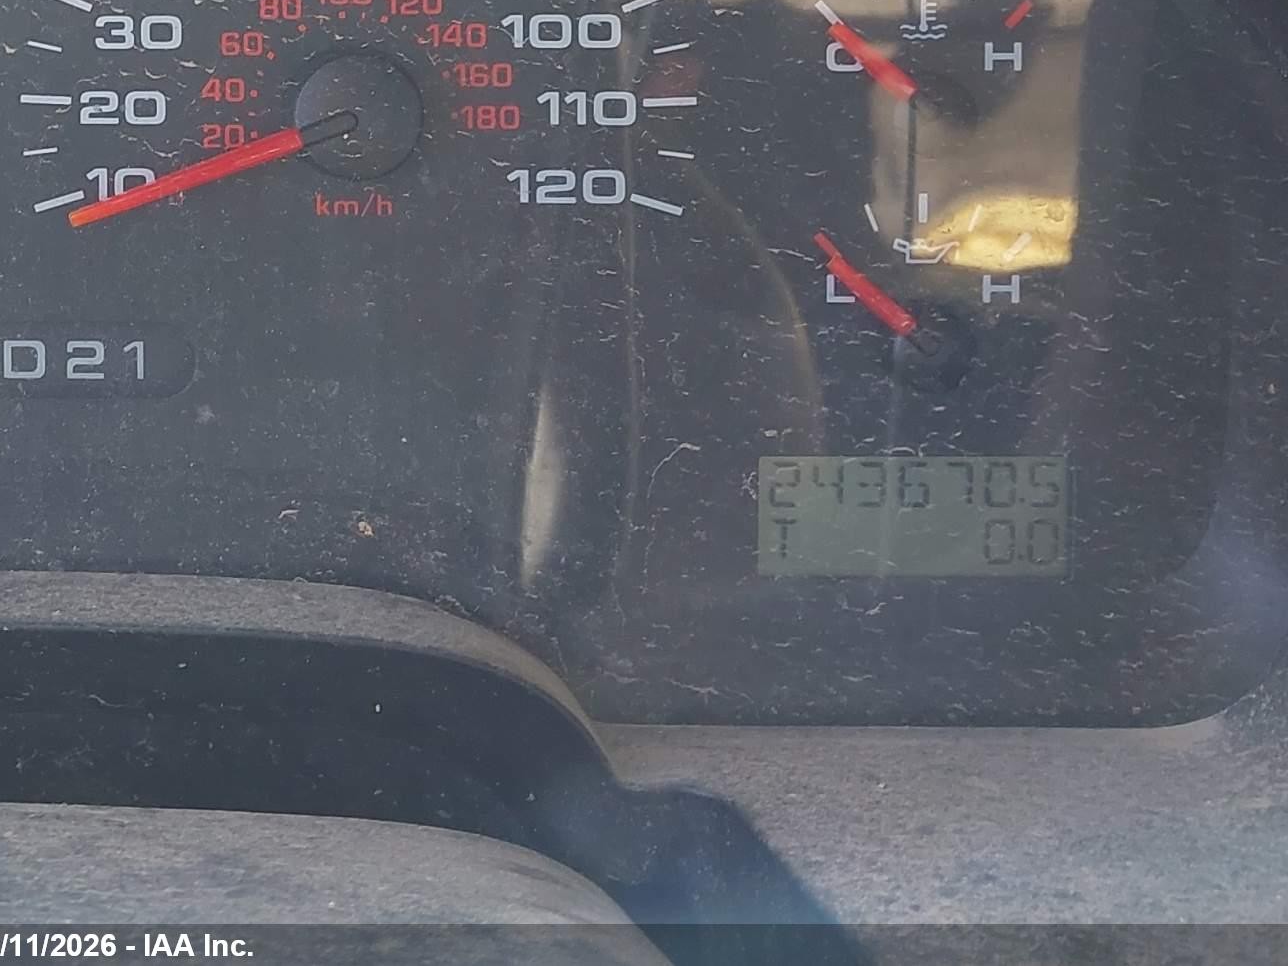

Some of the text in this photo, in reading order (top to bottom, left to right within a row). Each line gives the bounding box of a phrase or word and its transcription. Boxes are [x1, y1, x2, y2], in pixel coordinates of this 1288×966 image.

[94, 15, 183, 49] 30
[220, 32, 264, 57] 60
[426, 23, 487, 48] 140
[501, 14, 622, 48] 100
[984, 42, 1022, 71] H
[201, 78, 245, 103] 40
[455, 64, 513, 88] 160
[78, 91, 167, 125] 20
[462, 106, 520, 131] 180
[537, 91, 637, 126] 110
[202, 124, 245, 149] 20
[507, 169, 626, 205] 120
[316, 194, 393, 218] km/h
[826, 274, 856, 303] L
[982, 274, 1020, 303] H
[772, 519, 1059, 565] T 0.0
